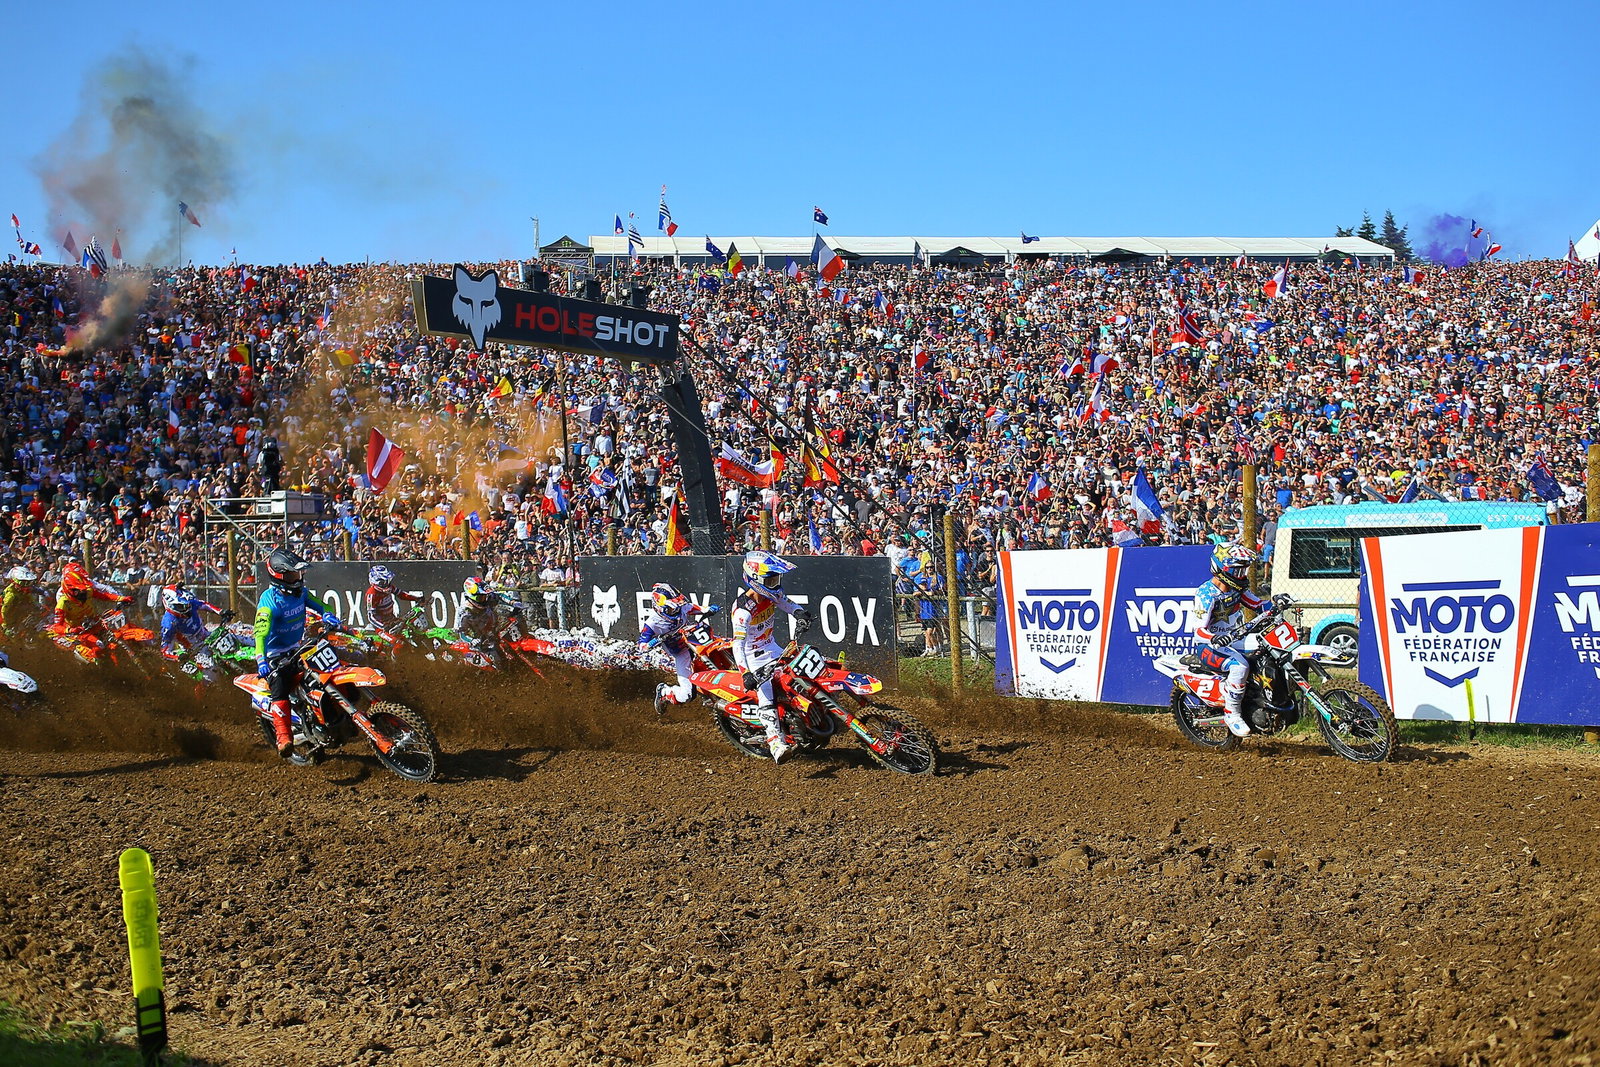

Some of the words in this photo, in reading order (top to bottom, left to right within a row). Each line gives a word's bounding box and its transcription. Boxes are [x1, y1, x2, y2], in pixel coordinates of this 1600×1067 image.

[515, 303, 669, 348] HOLESHOT
[1018, 600, 1100, 631] MOTO
[1126, 600, 1196, 633] MOT
[1390, 594, 1515, 634] MOTO
[693, 627, 710, 644] 5
[1026, 631, 1092, 644] FÉDÉRATION
[1274, 624, 1294, 649] 2
[1403, 635, 1502, 650] FÉDÉRATION
[312, 647, 338, 671] 119
[1030, 644, 1087, 655] FRANÇAISE
[1409, 651, 1496, 664] FRANÇAISE
[798, 649, 825, 679] 23
[1197, 680, 1214, 698] 2
[741, 704, 760, 720] 23
